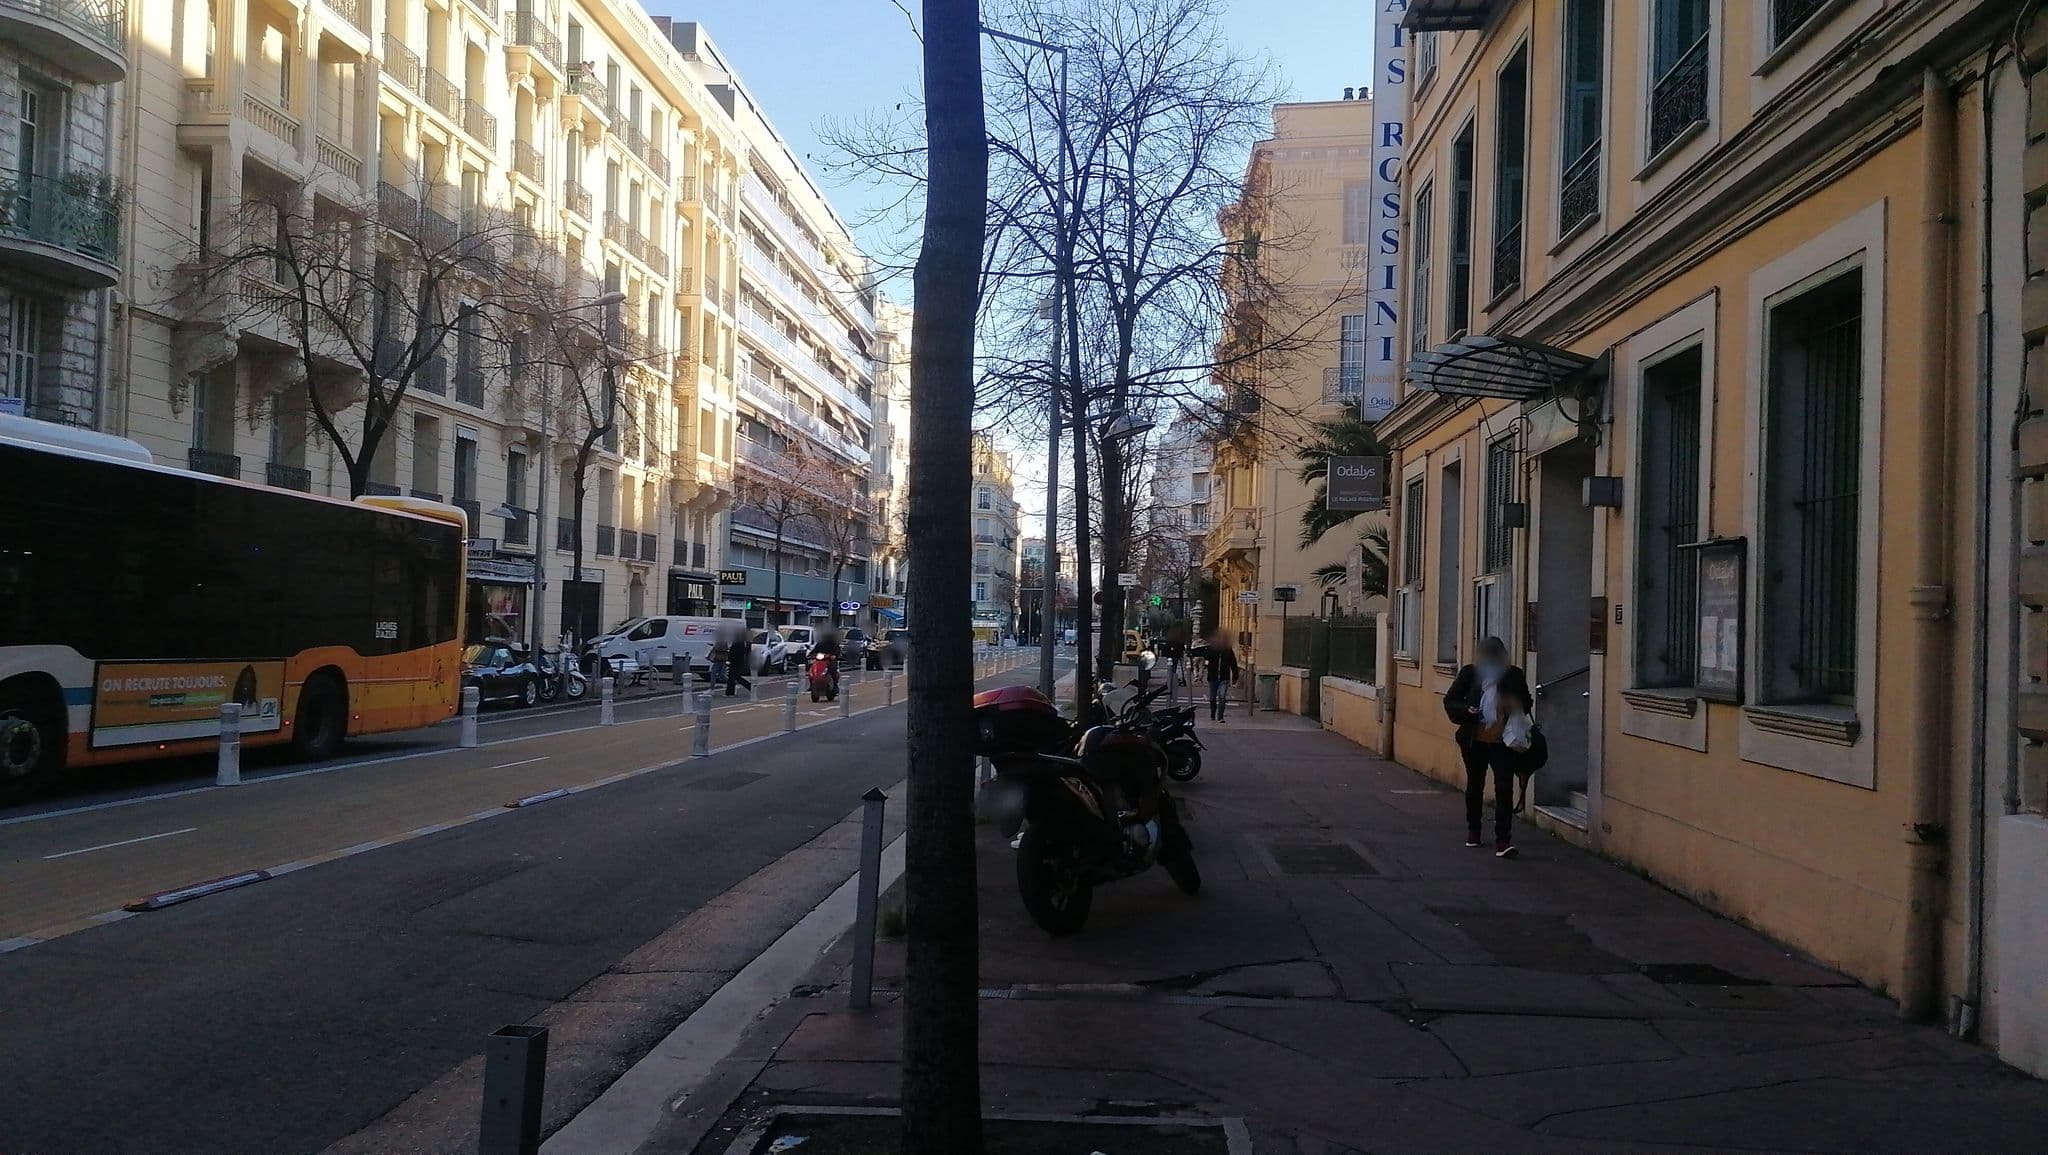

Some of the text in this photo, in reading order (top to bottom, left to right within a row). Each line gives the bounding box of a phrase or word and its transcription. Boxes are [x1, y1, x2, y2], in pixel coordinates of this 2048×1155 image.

[1374, 122, 1402, 362] ROSSINI
[1337, 465, 1376, 480] Odalys
[721, 572, 745, 581] PAUL
[688, 583, 705, 600] PAUL
[103, 679, 122, 692] ON
[124, 676, 171, 691] RECRUTE
